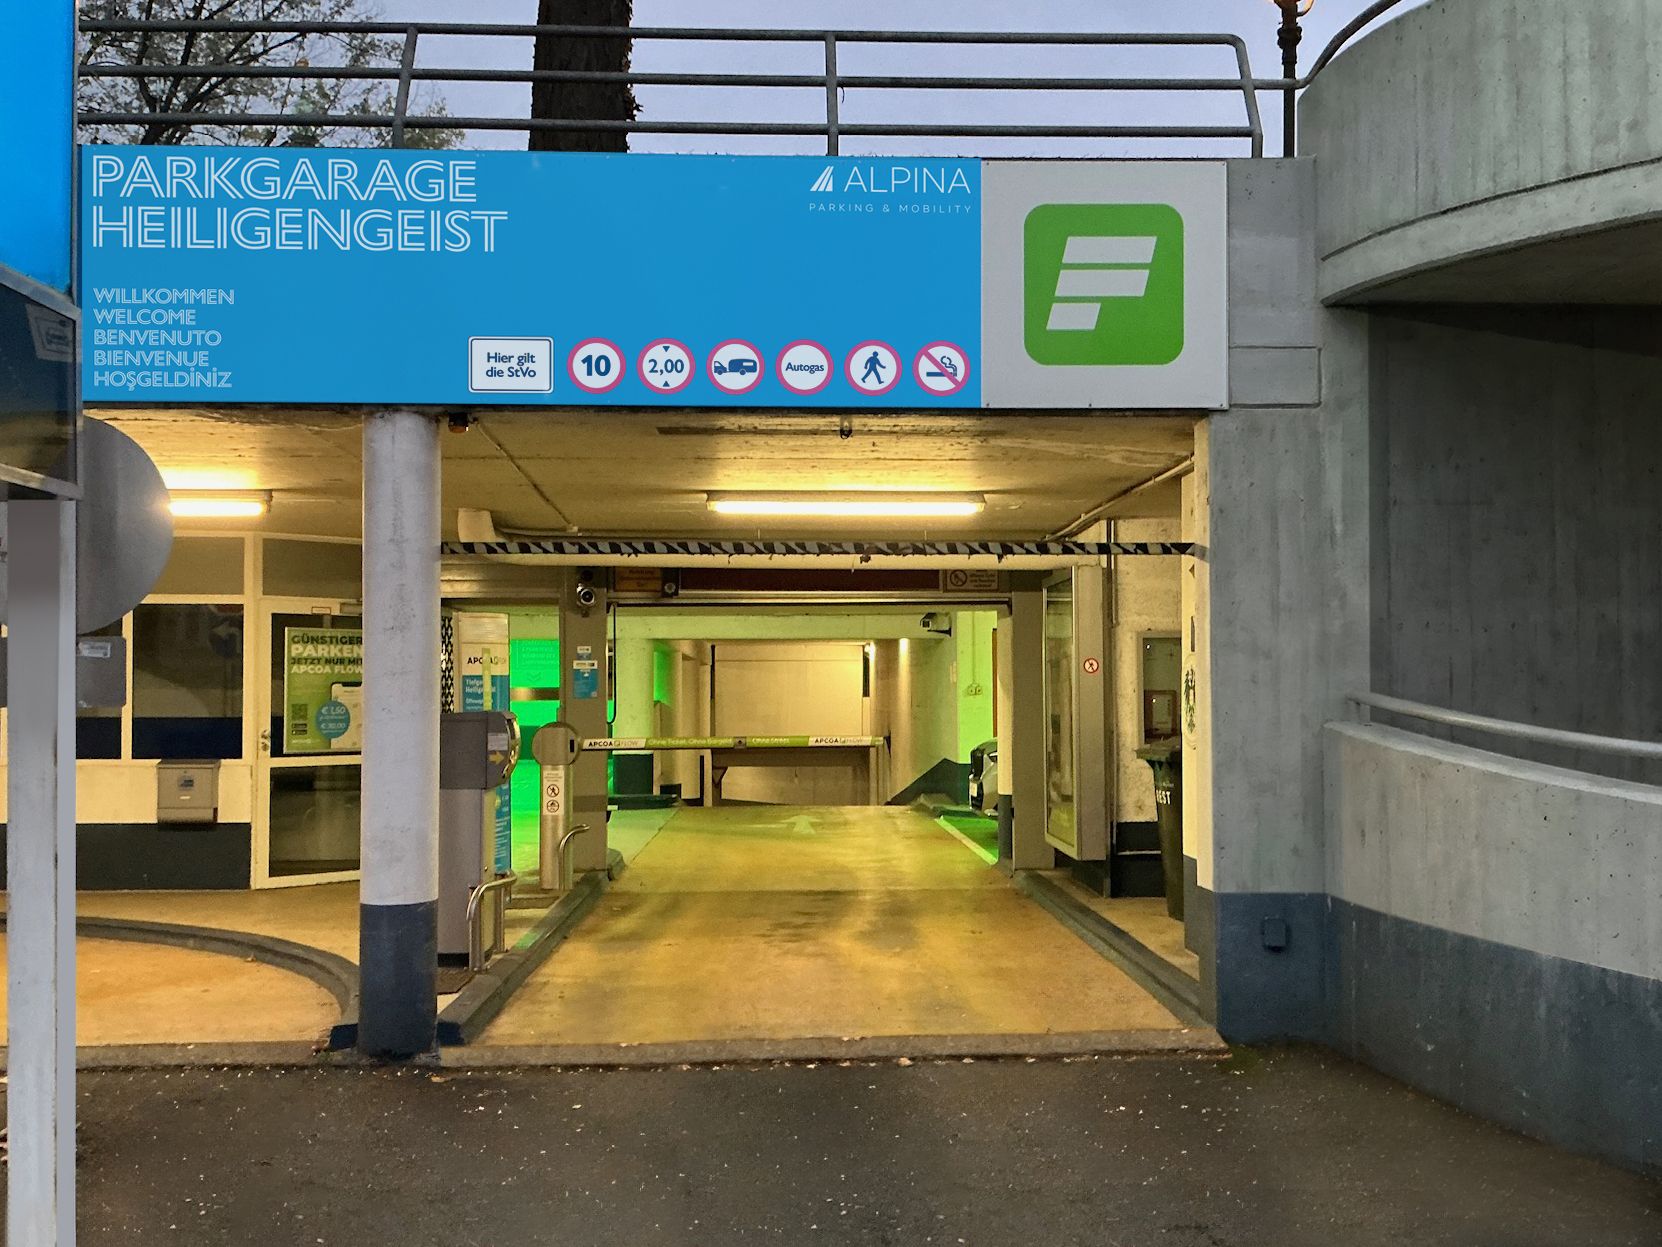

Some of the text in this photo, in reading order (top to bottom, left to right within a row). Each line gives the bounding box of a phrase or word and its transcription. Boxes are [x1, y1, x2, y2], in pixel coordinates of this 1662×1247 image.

[92, 155, 478, 203] PARKGARAGE
[844, 166, 971, 194] ALPINA
[809, 203, 971, 214] PARKING & MOBILITY
[92, 205, 509, 254] HEILIGENGEIST
[93, 287, 235, 306] WILLKOMMEN
[93, 308, 197, 326] WELCOME
[93, 328, 222, 346] BENVENUTO
[94, 349, 210, 367] BIENVENUE
[486, 351, 536, 367] Hier gilt
[580, 354, 612, 377] 10
[648, 357, 686, 376] 2,00
[485, 365, 537, 378] die StVo
[785, 361, 825, 375] Autogas
[291, 645, 362, 657] PARKEN
[291, 657, 322, 665] JETZT
[324, 657, 346, 665] NUR
[291, 665, 332, 674] APCOA
[588, 740, 614, 748] APCOA
